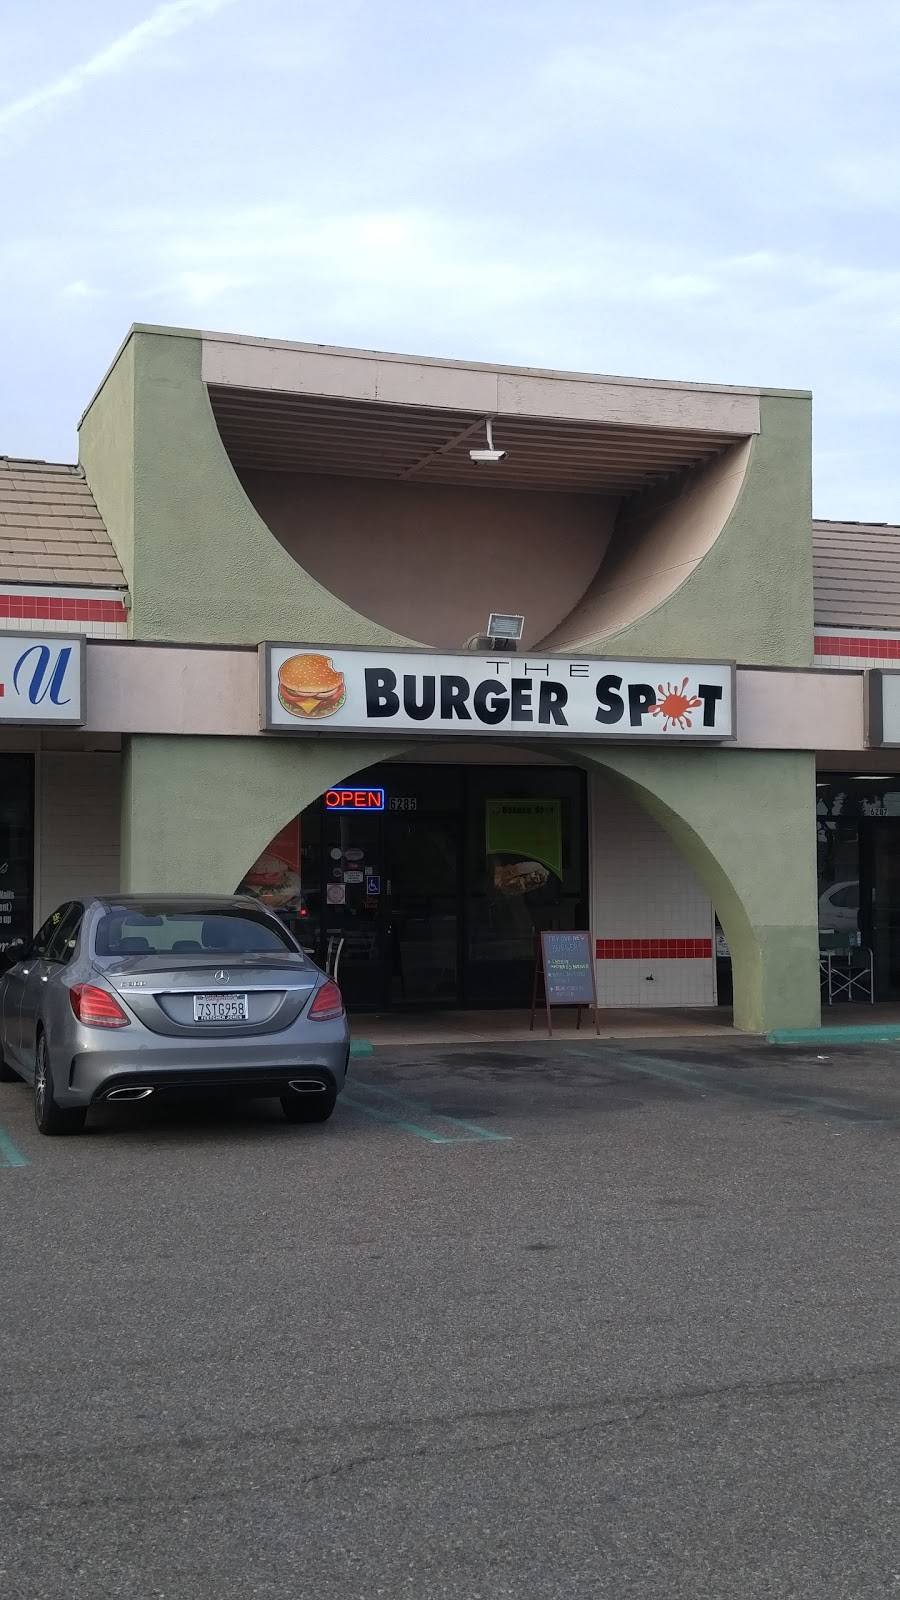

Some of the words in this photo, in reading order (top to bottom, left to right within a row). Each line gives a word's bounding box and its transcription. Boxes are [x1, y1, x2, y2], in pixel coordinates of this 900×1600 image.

[486, 660, 590, 677] THE
[364, 667, 569, 726] BURGER
[325, 791, 381, 807] OPEN
[198, 1002, 244, 1016] 7STG958
